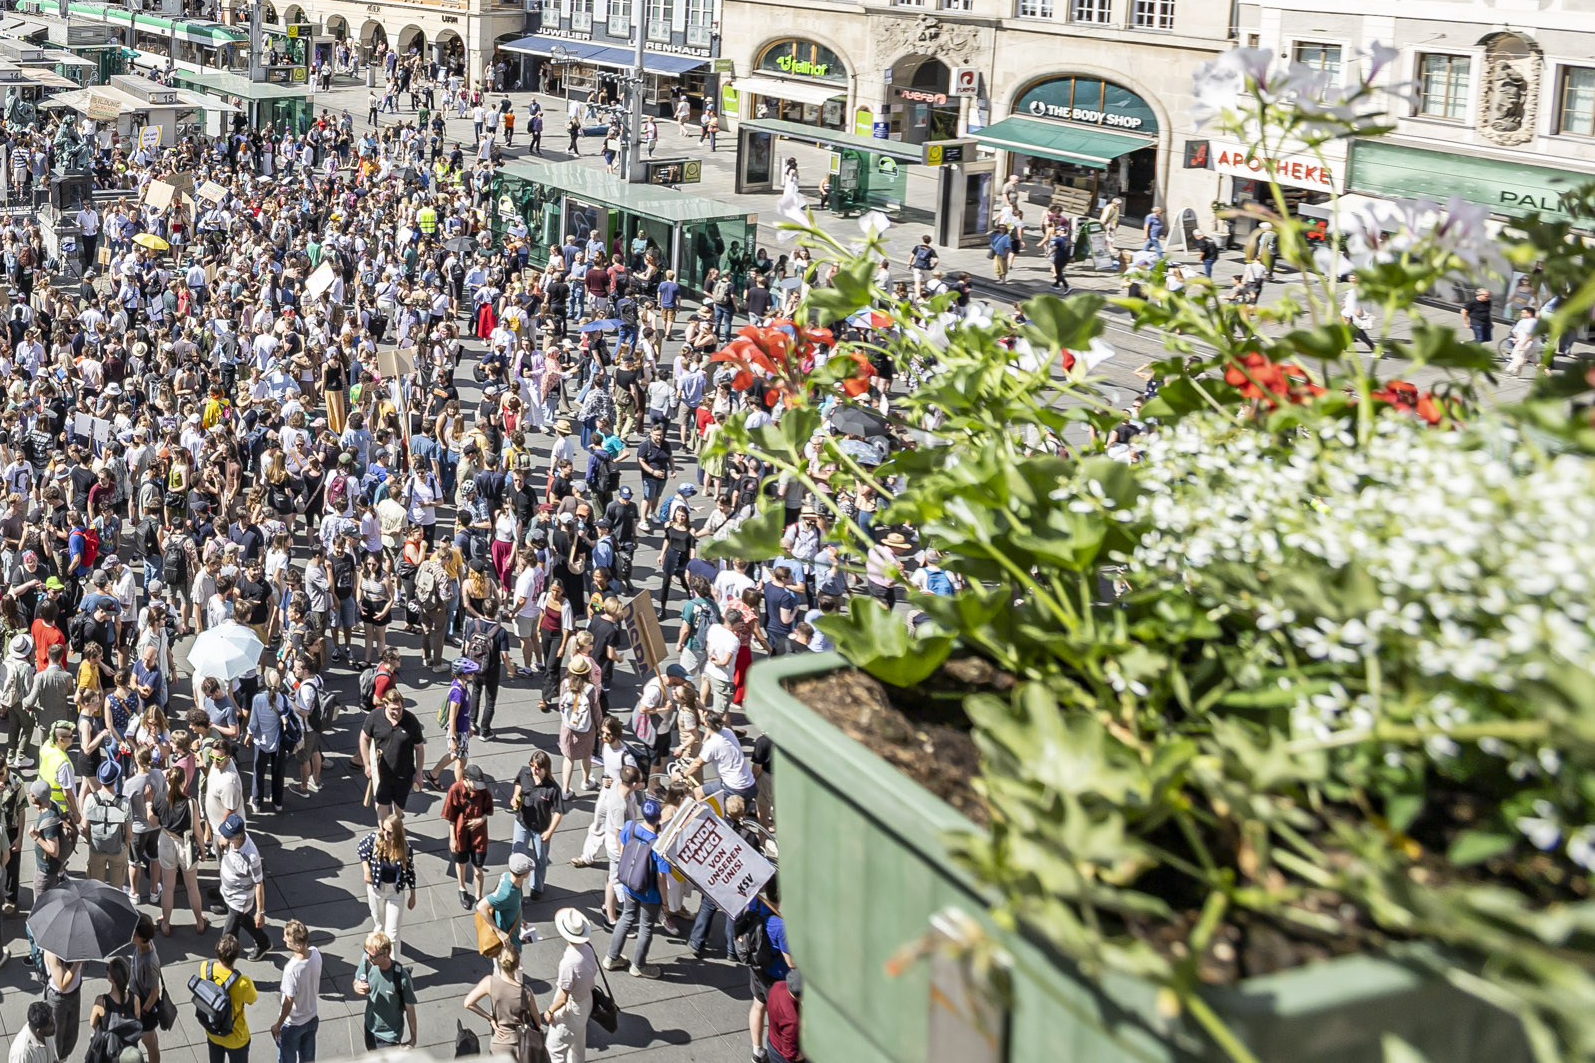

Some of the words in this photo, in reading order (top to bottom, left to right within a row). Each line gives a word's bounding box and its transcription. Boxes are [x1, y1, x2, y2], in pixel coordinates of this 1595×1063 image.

[536, 26, 592, 41] JUWELIER
[627, 39, 712, 57] URENHAUS
[163, 95, 174, 103] 15
[1047, 105, 1071, 117] THE
[1072, 108, 1106, 123] BODY
[1106, 114, 1142, 128] SHOP
[679, 818, 715, 864] HÄNDE
[693, 833, 721, 865] WEG
[708, 848, 727, 869] VON
[708, 844, 743, 886] UNSEREN
[721, 859, 744, 885] UNIS!
[737, 873, 754, 893] KSV
